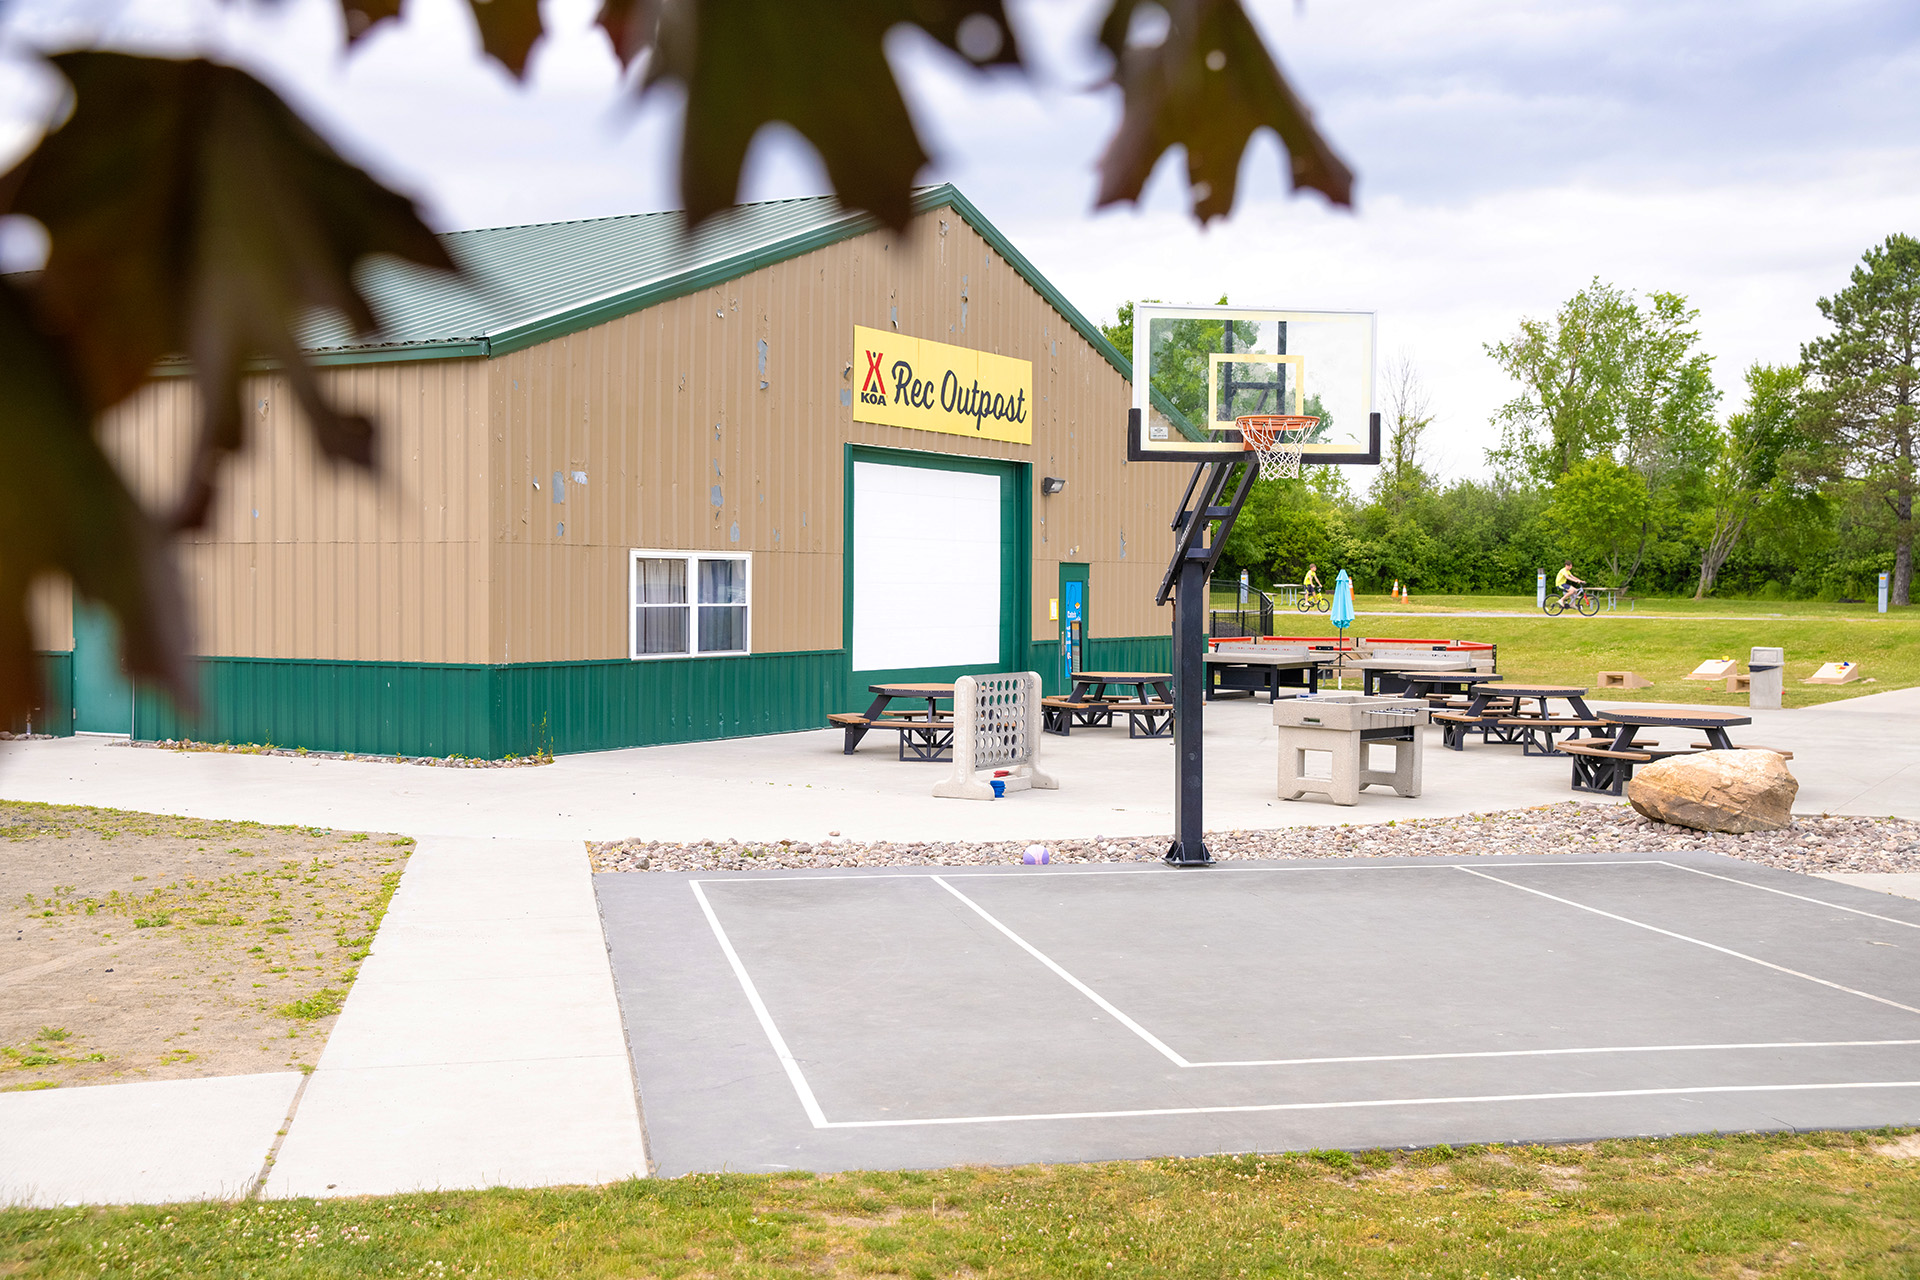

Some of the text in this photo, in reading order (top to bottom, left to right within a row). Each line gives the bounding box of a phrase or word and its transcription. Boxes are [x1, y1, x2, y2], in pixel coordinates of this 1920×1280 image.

[861, 392, 887, 407] KOA
[892, 361, 1027, 431] Rec Outpost
